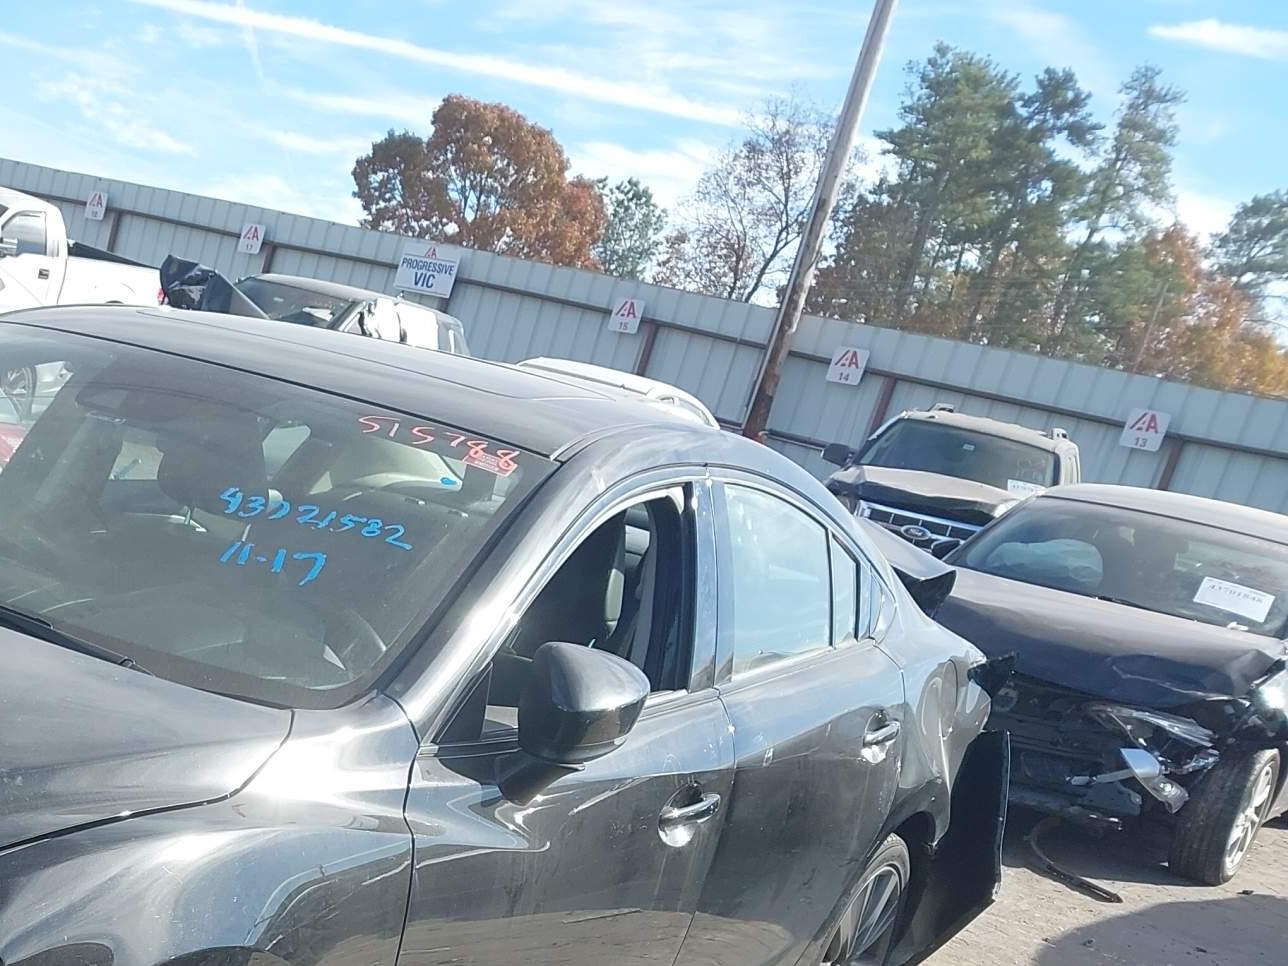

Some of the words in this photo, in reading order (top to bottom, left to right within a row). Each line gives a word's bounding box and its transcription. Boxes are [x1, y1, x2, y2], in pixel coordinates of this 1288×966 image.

[401, 257, 455, 276] PROGRESSIVE
[414, 271, 436, 289] VIC
[618, 321, 629, 331] 15
[839, 371, 850, 381] 14
[1134, 436, 1148, 448] 13
[219, 541, 327, 586] 11-17
